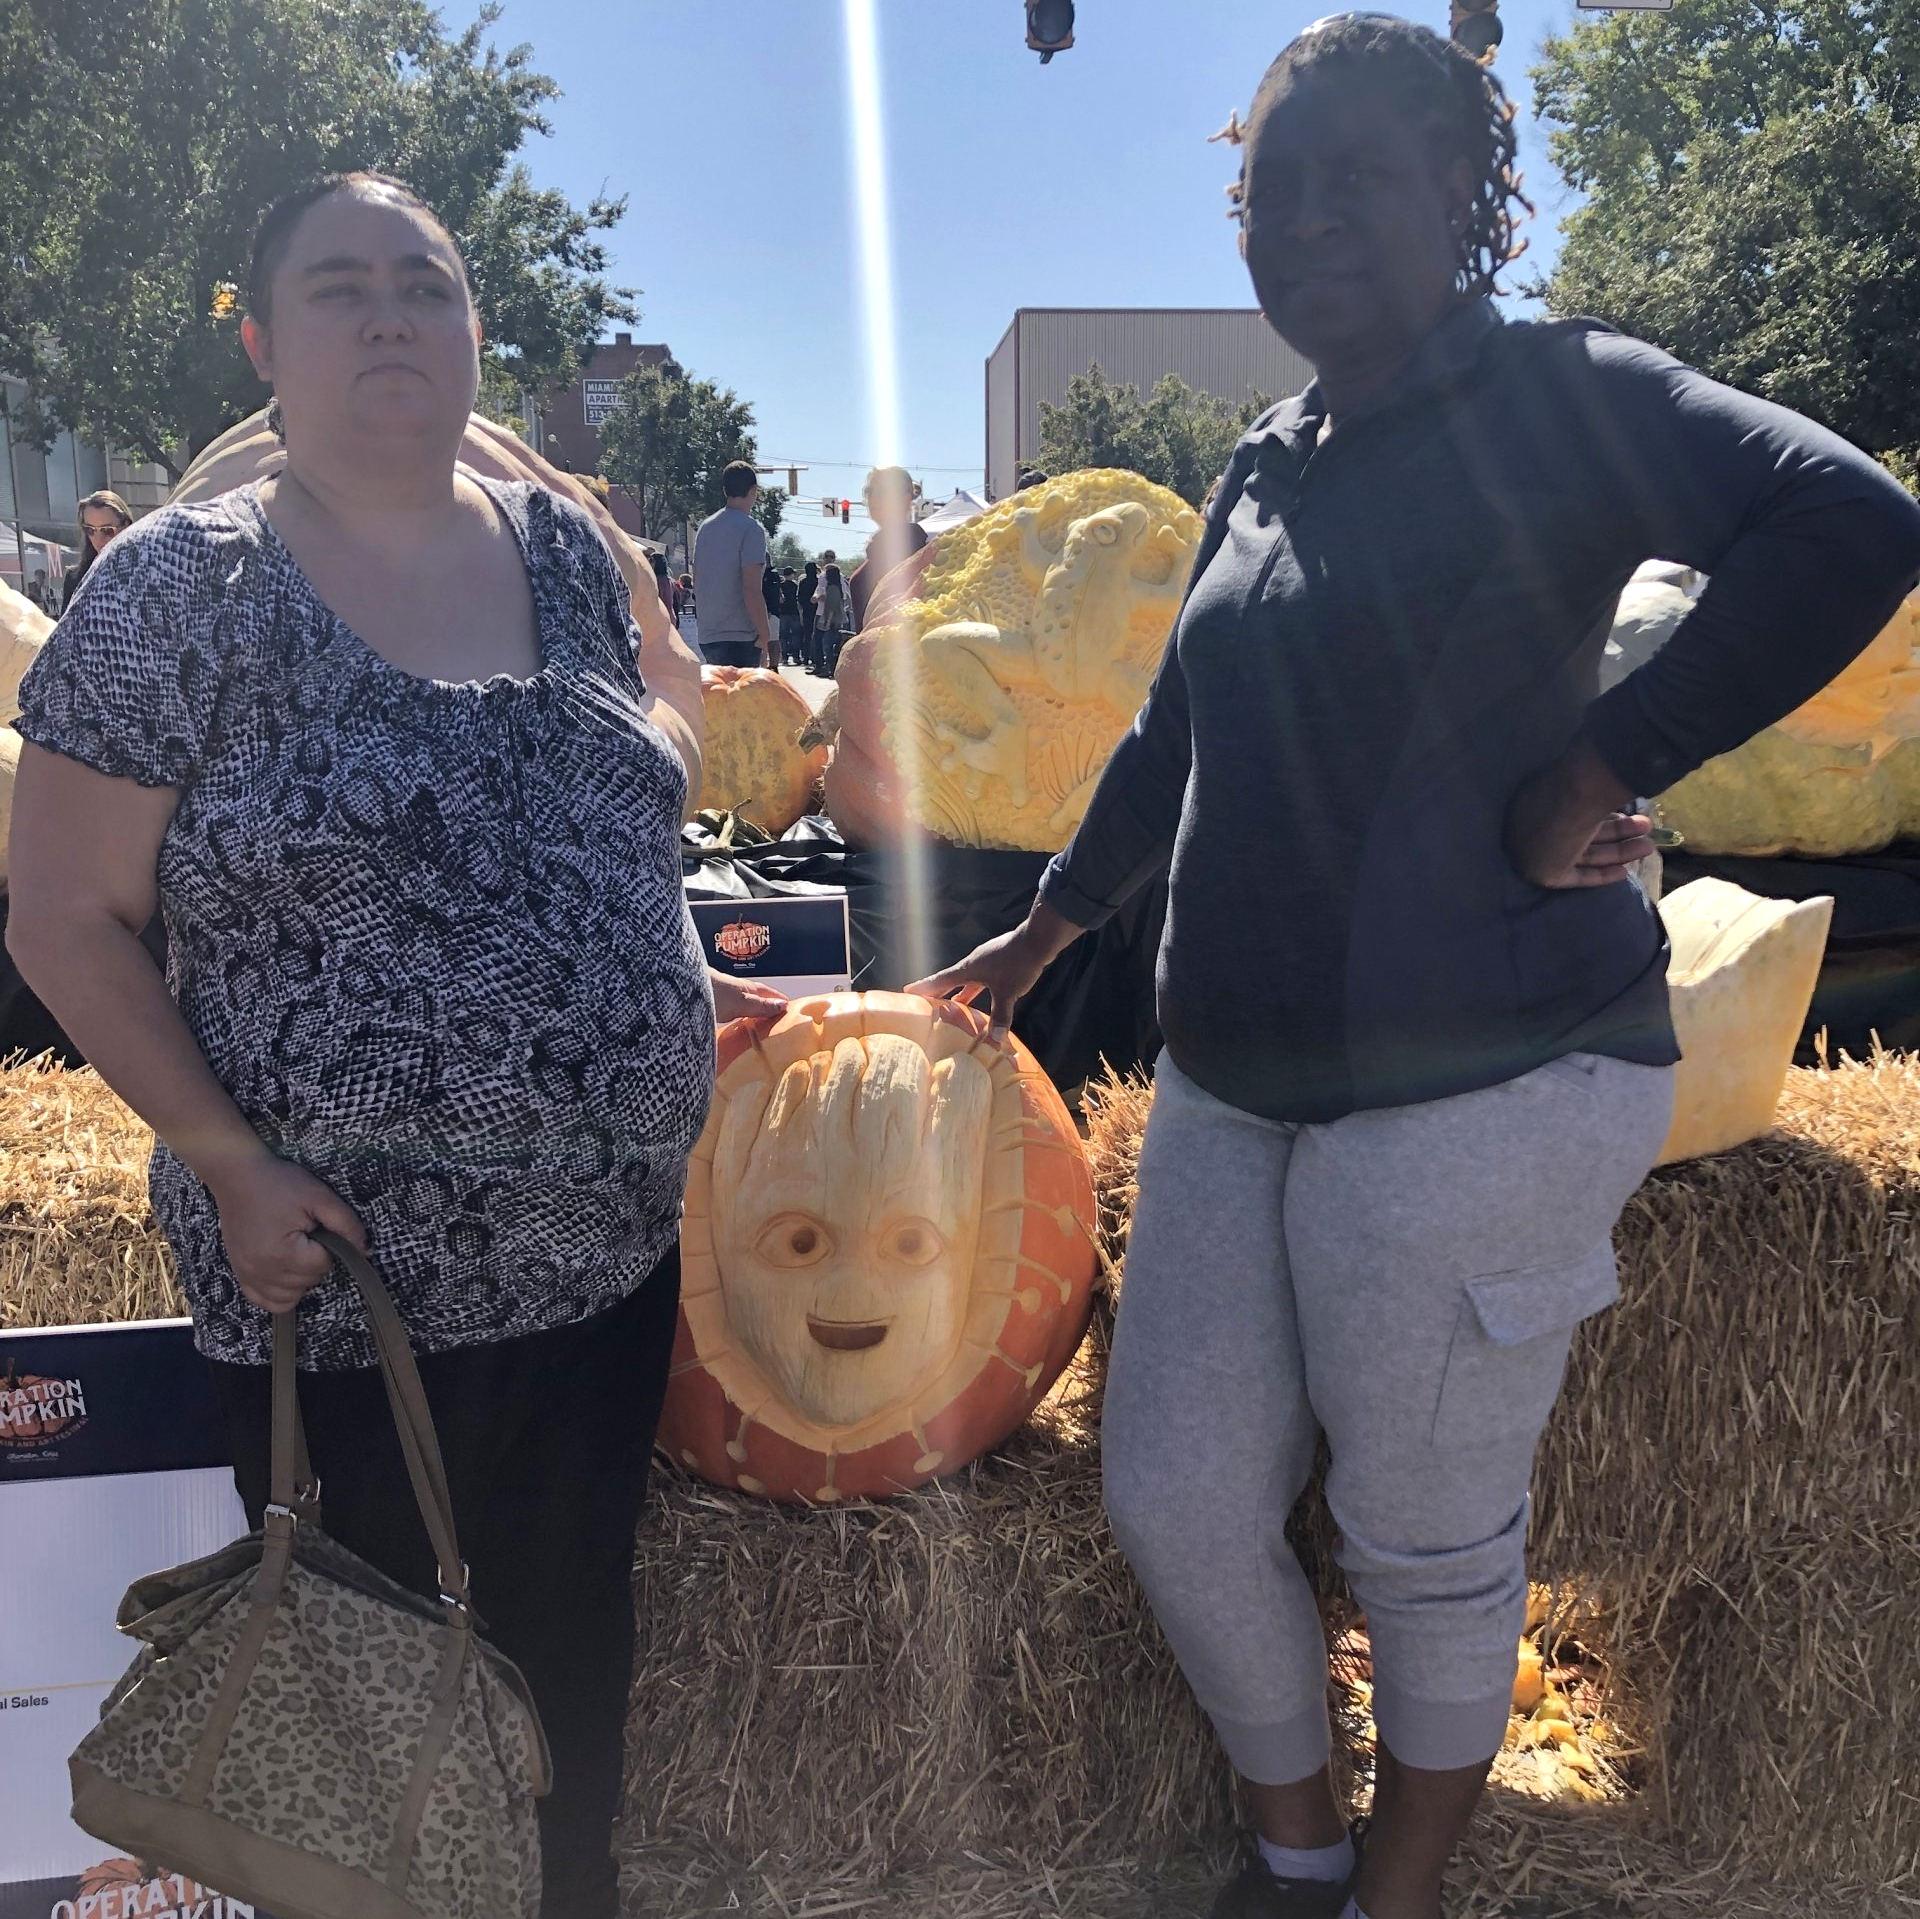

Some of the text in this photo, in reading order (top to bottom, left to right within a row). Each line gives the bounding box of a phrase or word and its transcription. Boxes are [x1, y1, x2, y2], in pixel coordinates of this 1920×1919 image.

[714, 925, 770, 942] OPERATION
[715, 934, 770, 953] PUMPKIN
[11, 1694, 49, 1709] Sales
[51, 1873, 220, 1919] OPERATI
